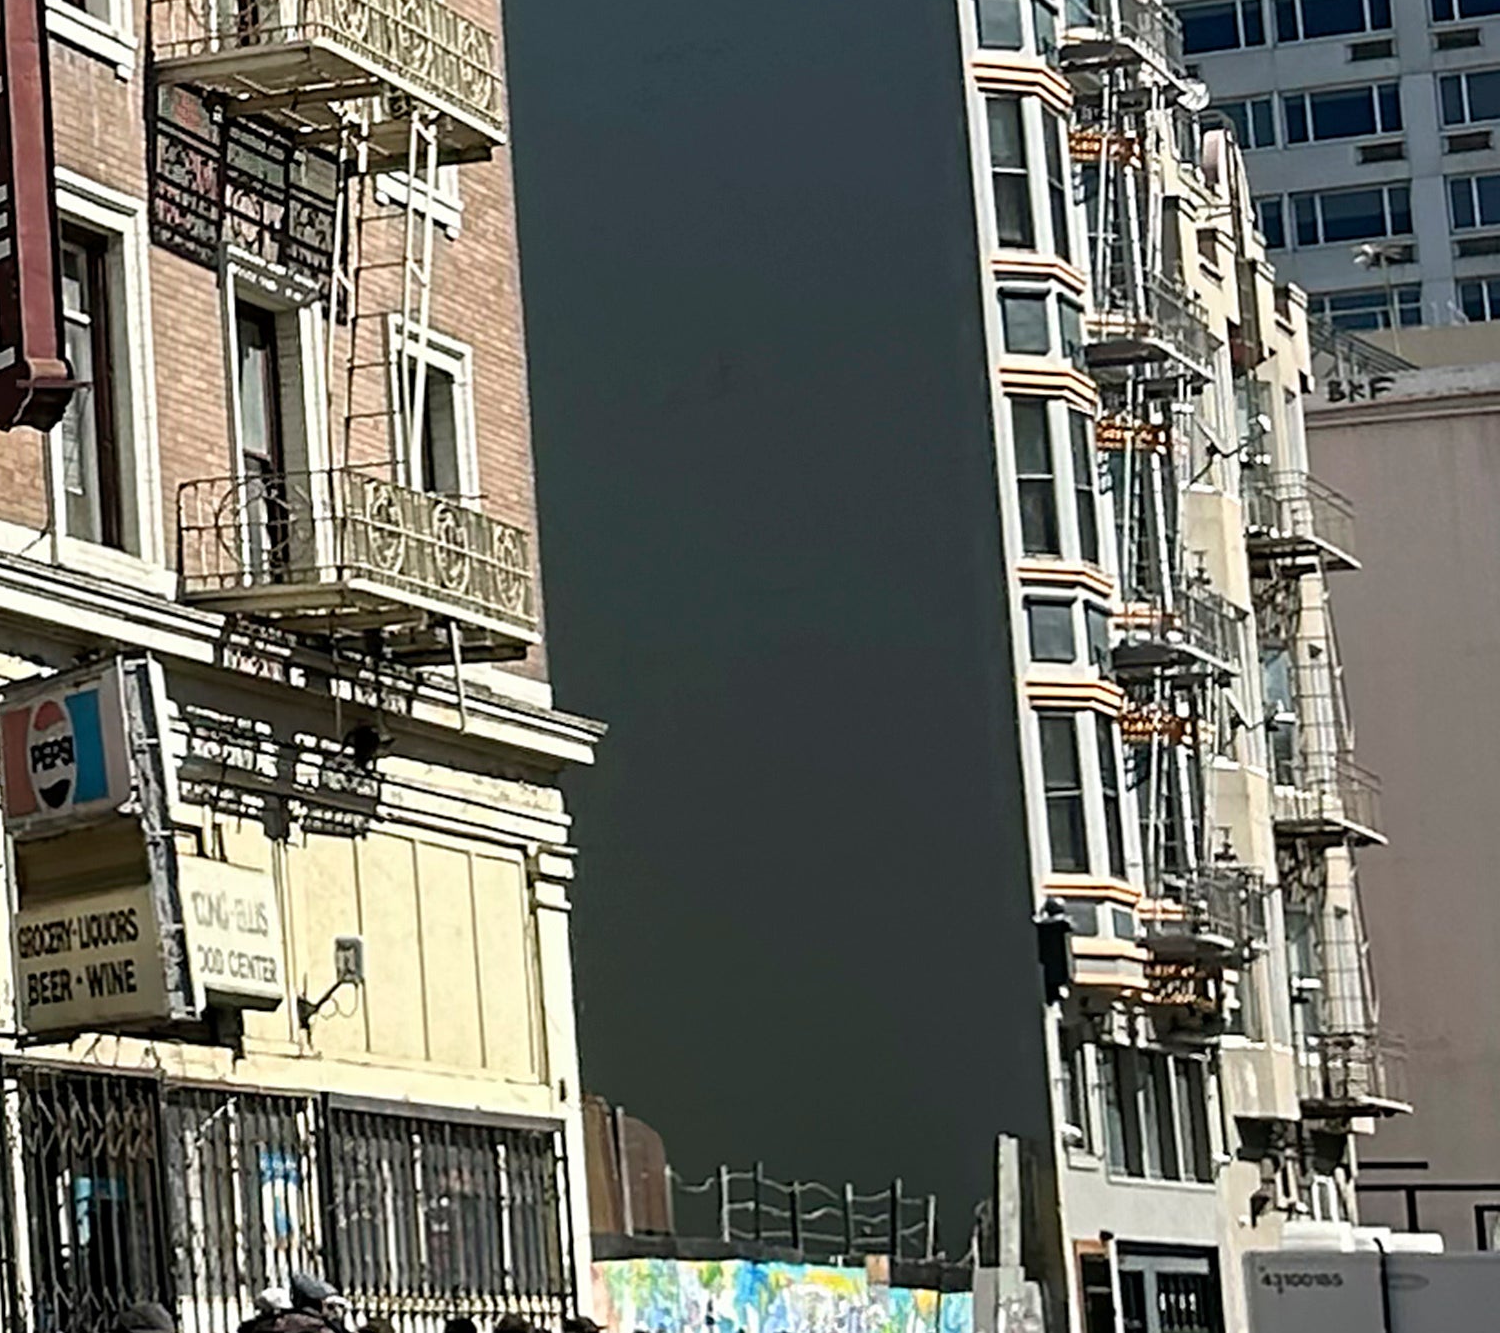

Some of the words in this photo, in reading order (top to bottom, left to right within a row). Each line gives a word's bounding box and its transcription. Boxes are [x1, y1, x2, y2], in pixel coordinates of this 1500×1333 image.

[30, 735, 75, 774] PEPSI
[28, 969, 73, 1006] BEER
[86, 959, 137, 998] WINE
